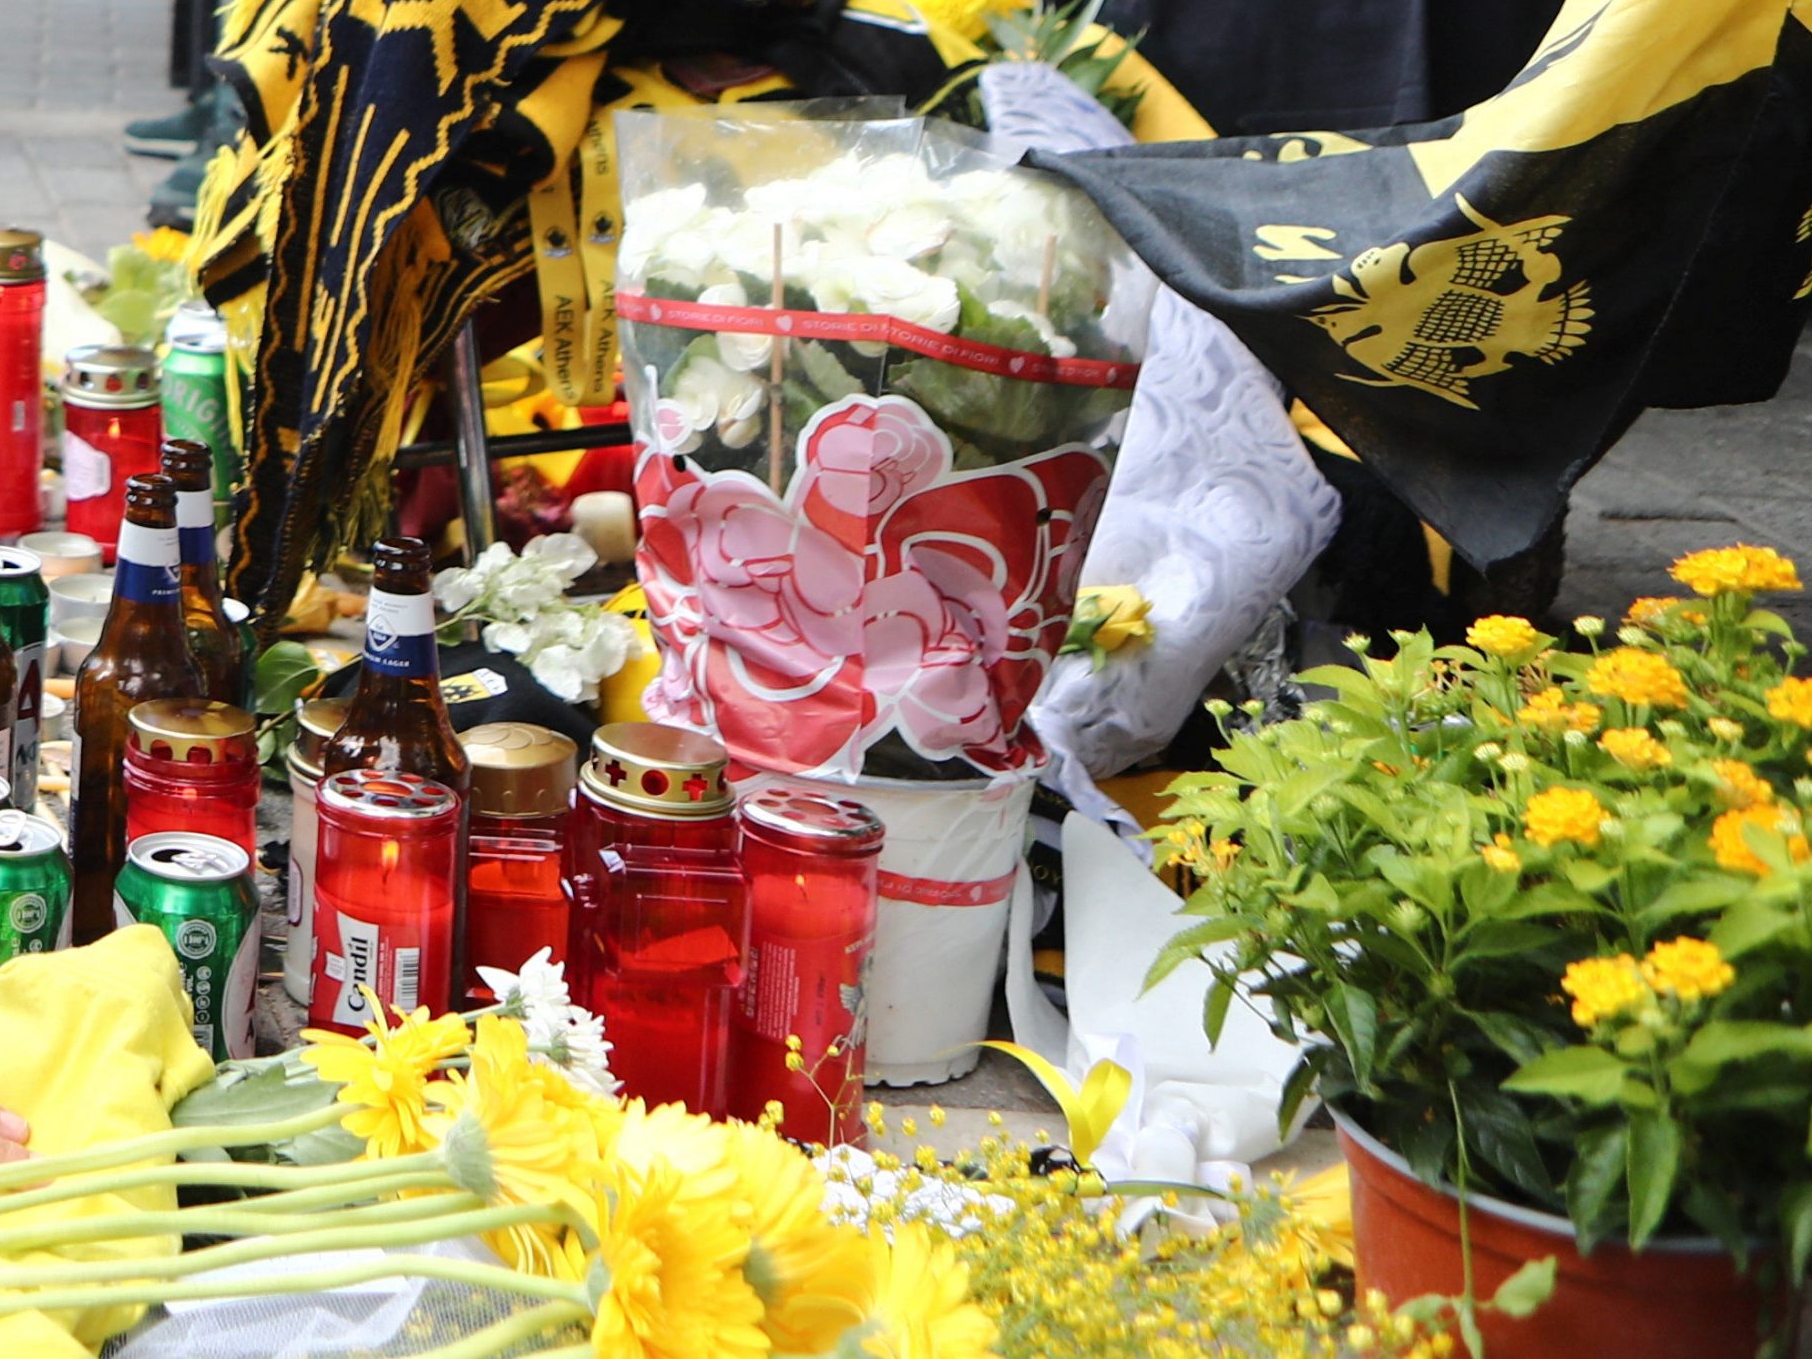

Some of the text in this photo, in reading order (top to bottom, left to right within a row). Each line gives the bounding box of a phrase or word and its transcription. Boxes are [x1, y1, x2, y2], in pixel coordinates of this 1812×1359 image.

[554, 294, 576, 401] AEK Athens
[592, 329, 613, 394] Athens
[348, 936, 369, 1013] Candil
